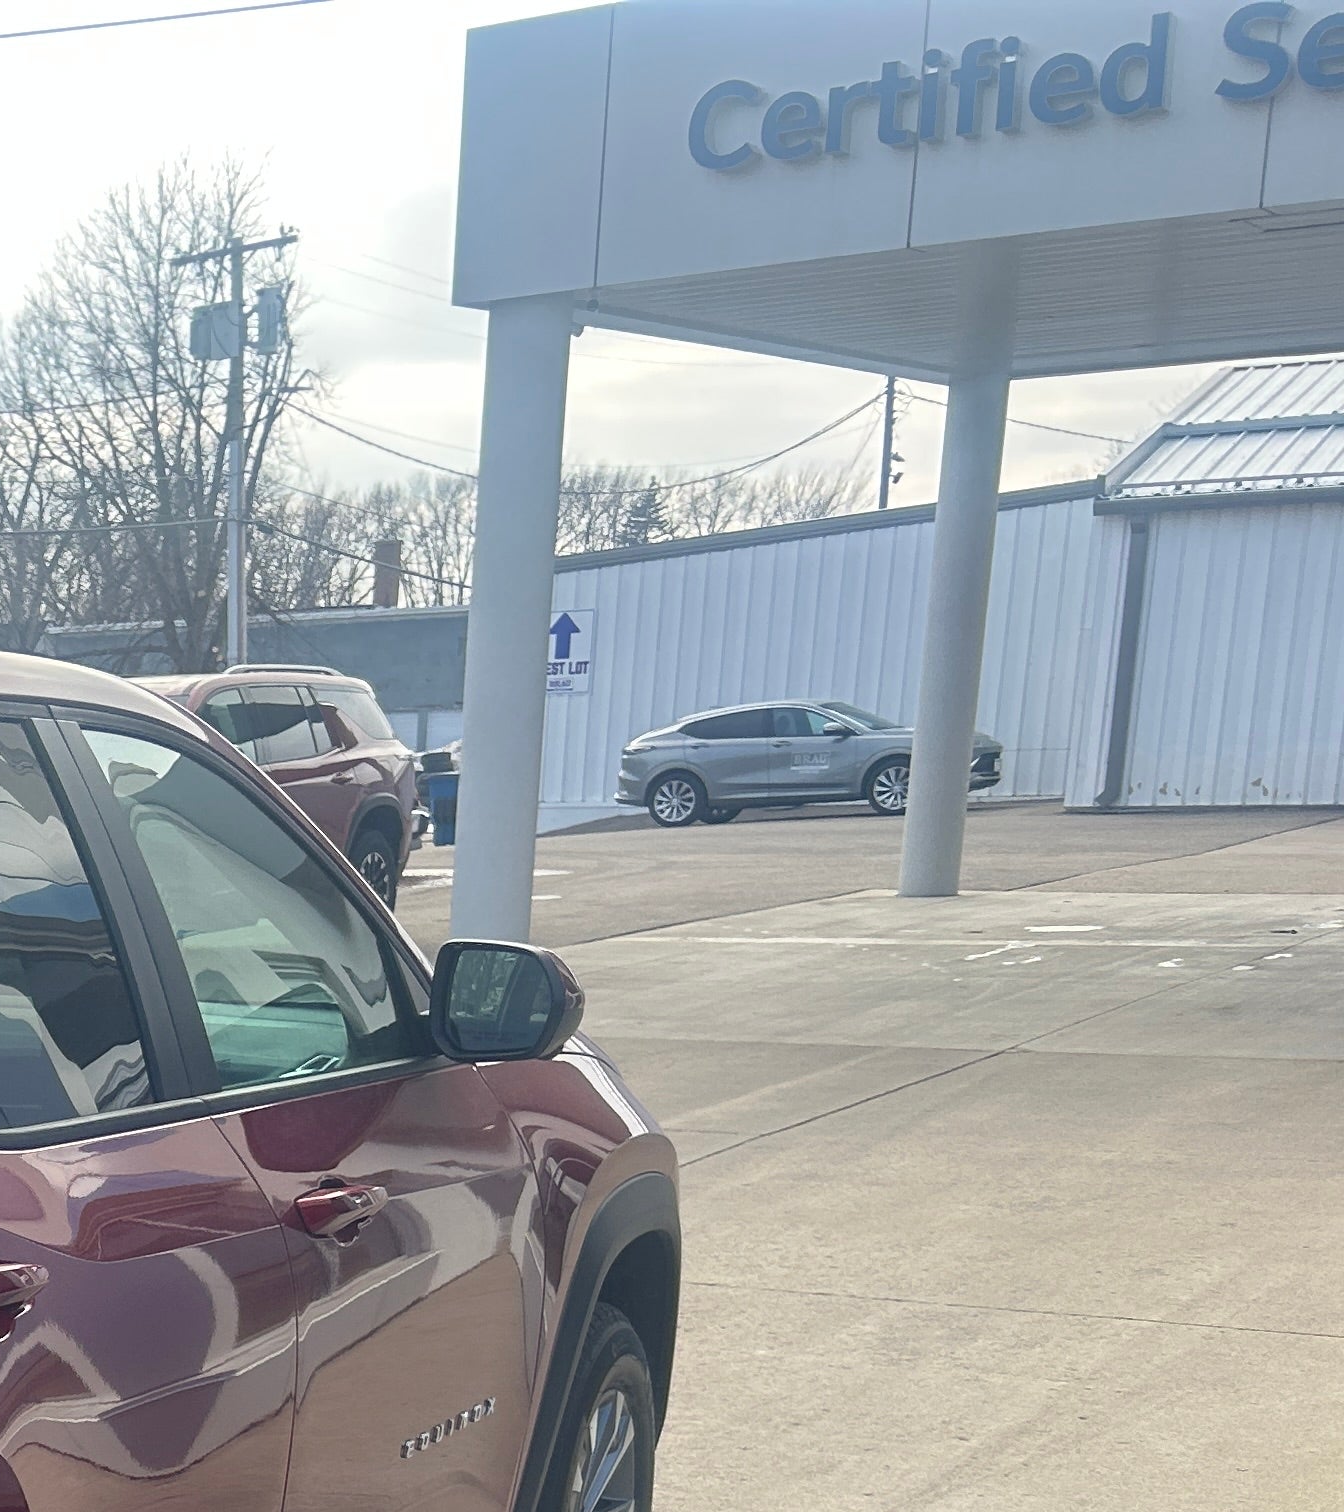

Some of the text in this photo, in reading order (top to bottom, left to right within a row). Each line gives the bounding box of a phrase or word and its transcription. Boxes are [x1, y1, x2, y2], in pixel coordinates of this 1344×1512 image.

[688, 0, 1344, 171] Certified Se
[568, 661, 590, 675] LOT
